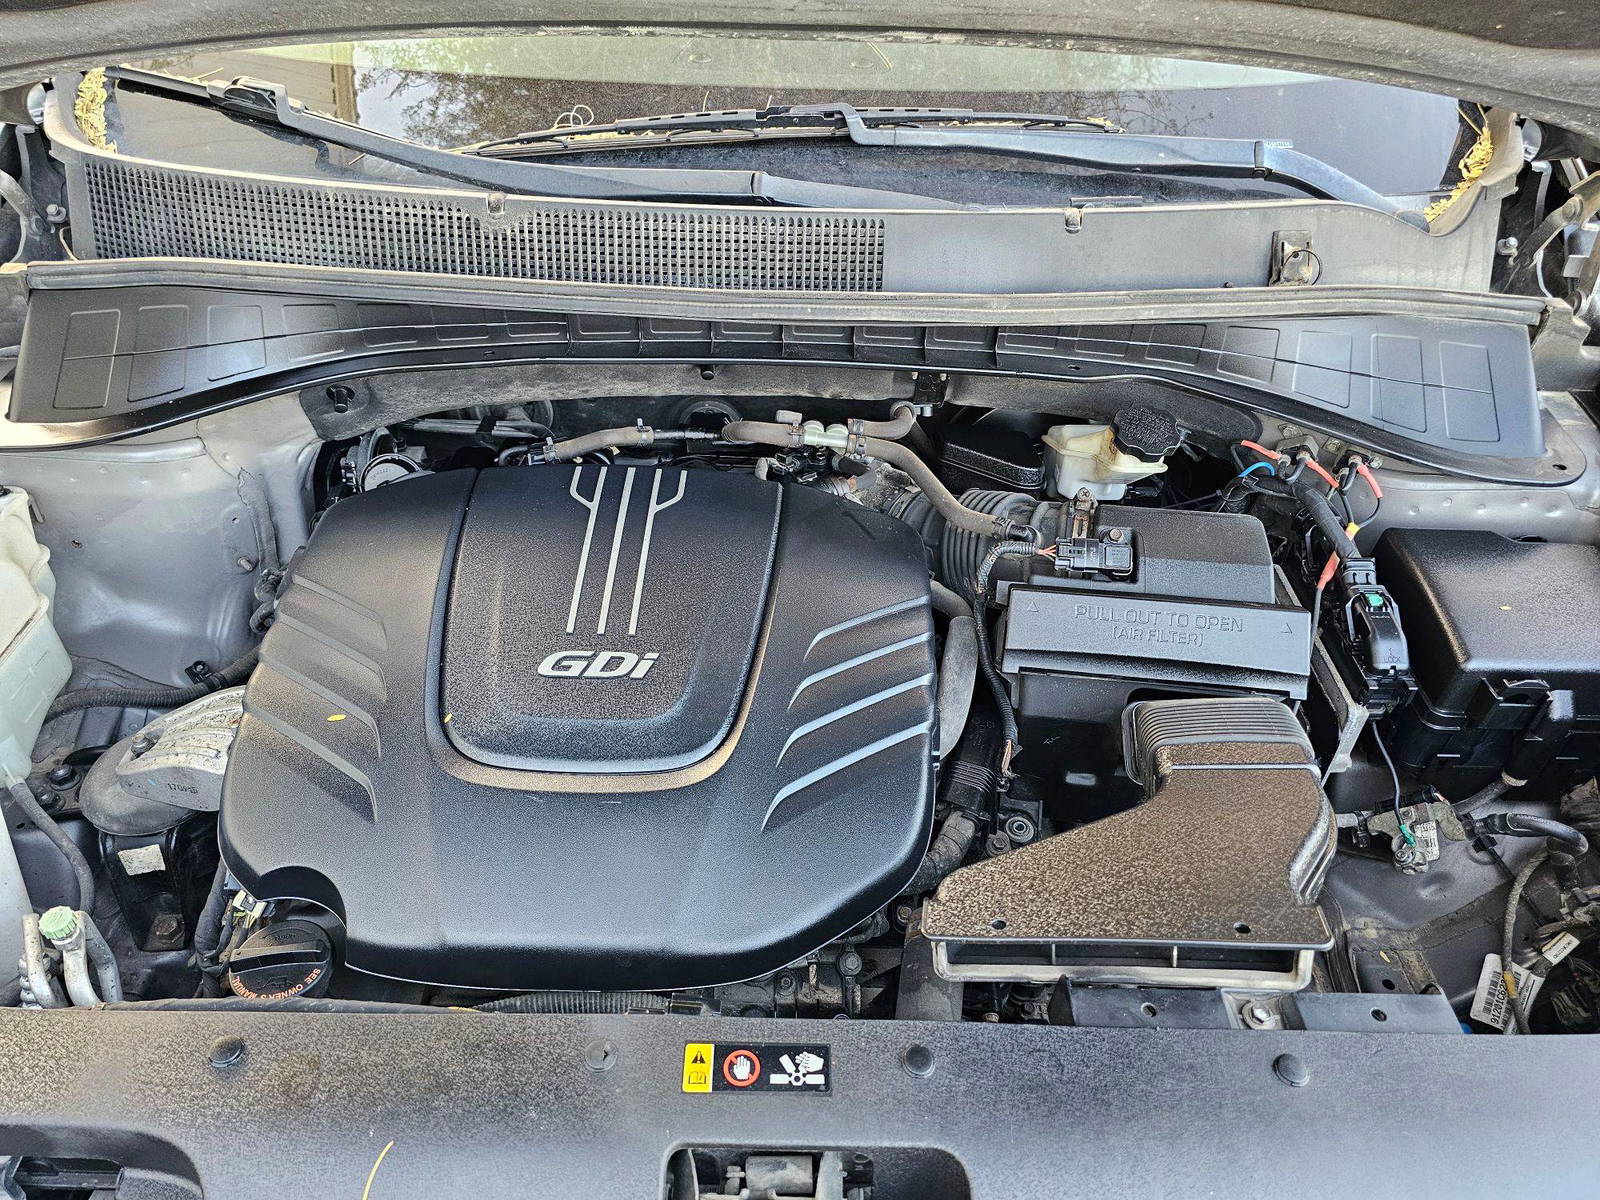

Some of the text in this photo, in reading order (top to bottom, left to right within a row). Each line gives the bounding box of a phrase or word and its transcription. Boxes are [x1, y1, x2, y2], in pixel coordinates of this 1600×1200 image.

[1074, 604, 1244, 633] PULL OUT TO OPEN
[1112, 625, 1205, 648] (AIR FILTER)
[537, 650, 660, 679] GDi
[231, 975, 258, 1000] MANUAL
[303, 967, 322, 985] SEE
